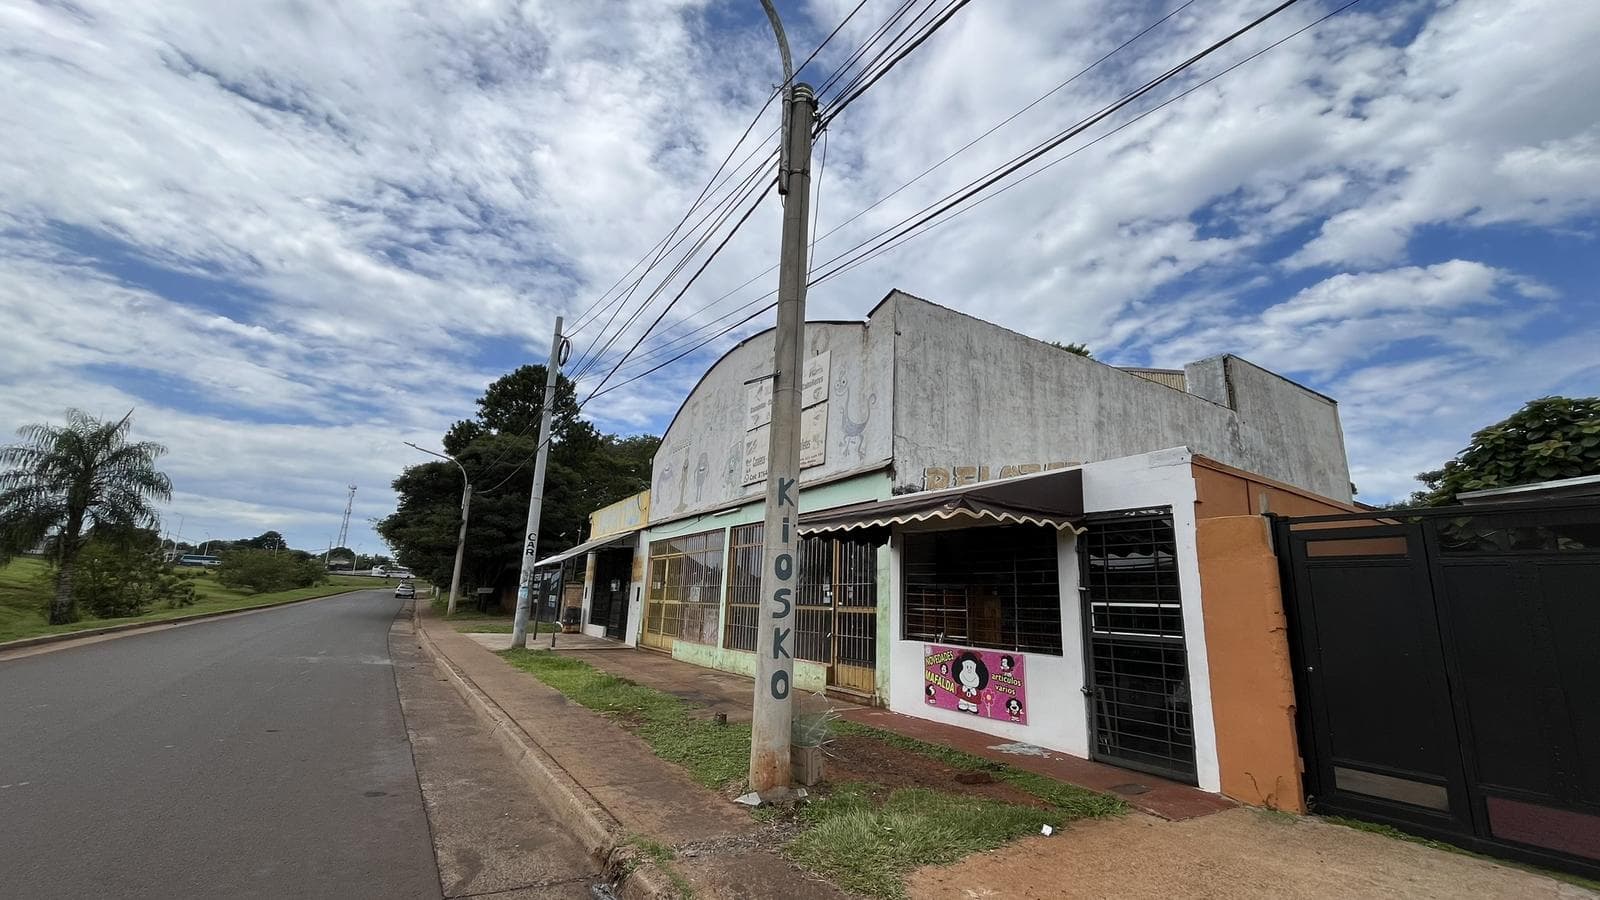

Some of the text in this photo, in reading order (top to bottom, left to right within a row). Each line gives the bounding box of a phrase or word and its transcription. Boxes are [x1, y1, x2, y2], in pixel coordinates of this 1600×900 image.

[526, 532, 537, 556] CAR
[925, 650, 954, 667] NOVEDADES
[925, 669, 956, 694] MAFALDA
[994, 684, 1016, 696] varios
